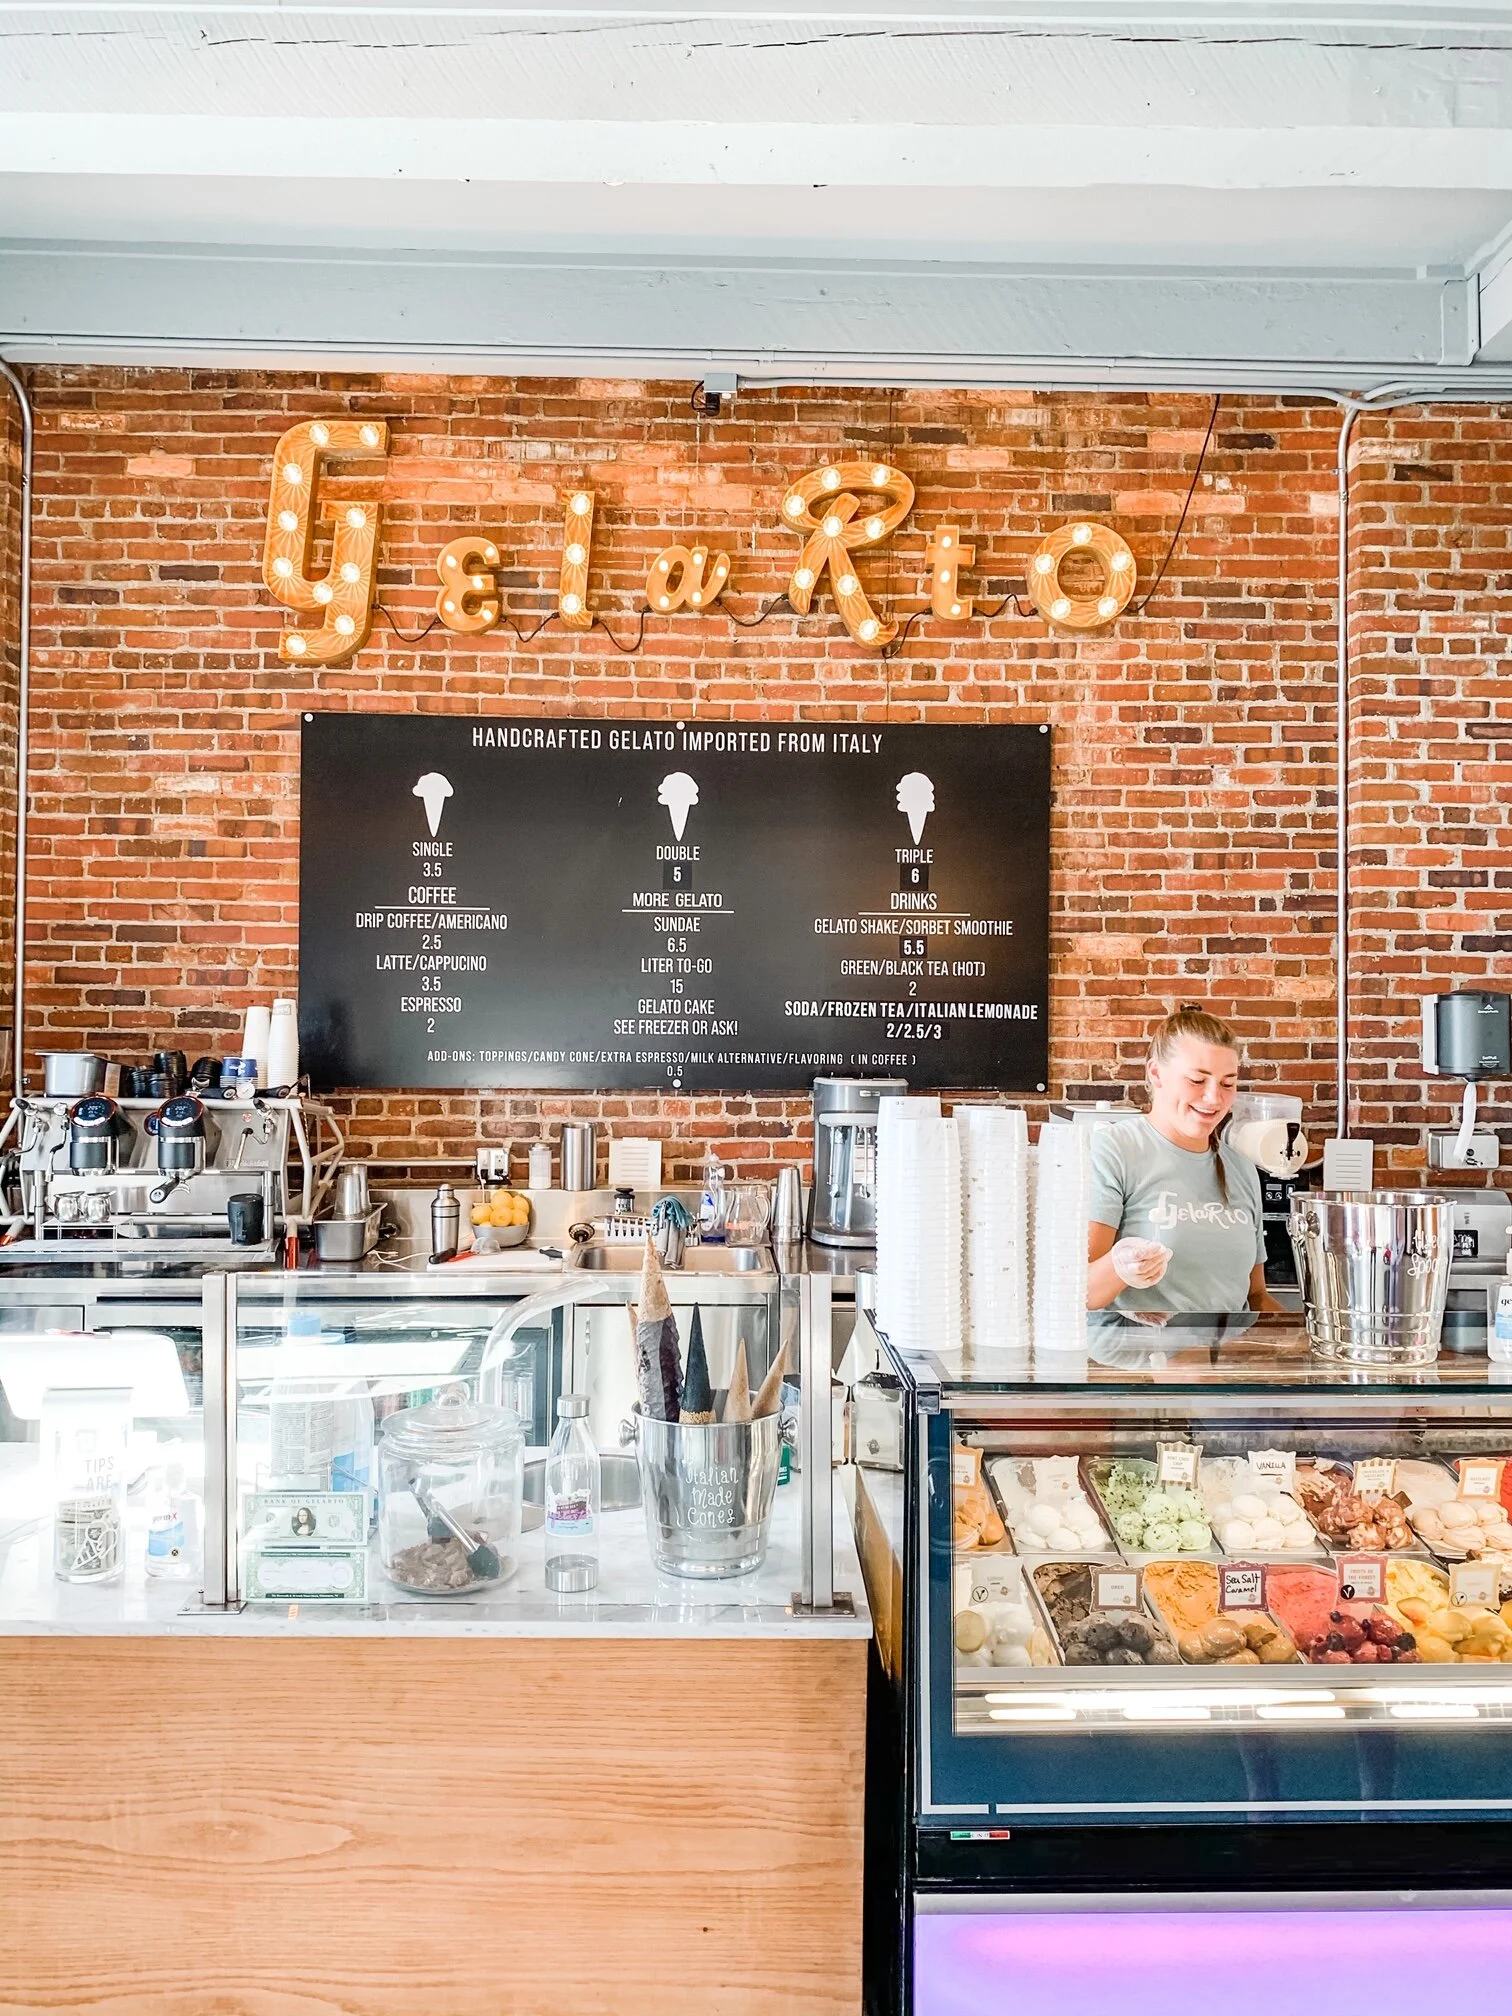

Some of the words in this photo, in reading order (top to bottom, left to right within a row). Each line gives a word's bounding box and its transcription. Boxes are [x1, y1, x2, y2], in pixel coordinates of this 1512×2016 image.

[472, 727, 602, 750] HANDCRAFTED
[609, 729, 675, 751] GELATO
[682, 731, 771, 752] IMPORTED
[778, 732, 825, 753] FROM
[833, 733, 883, 754] ITALY
[412, 841, 453, 857] SINGLE
[656, 845, 701, 861] DOUBLE
[894, 848, 934, 864] TRIPLE
[422, 861, 442, 878] 3.5
[673, 866, 682, 882] 5
[911, 867, 920, 884] 6
[408, 885, 457, 905] COFFEE
[634, 892, 670, 907] MORE
[675, 892, 723, 908] GELATO
[890, 892, 938, 911] DRINKS
[355, 912, 384, 928] DRIP
[387, 912, 508, 930] COFFEE/AMERICANO
[655, 916, 701, 932] SUNDAE
[814, 918, 858, 934] GELATO
[860, 918, 952, 935] SHAKE/SORBET
[953, 919, 1014, 936] SMOOTHIE
[422, 934, 442, 950] 2.5
[667, 937, 687, 953] 6.5
[903, 939, 925, 956] 5.5
[376, 953, 487, 972] LATTE/CAPPUCINO
[641, 957, 674, 973] LITER
[676, 957, 713, 974] TO-GO
[840, 958, 924, 976] GREEN/BLACK
[926, 960, 949, 976] TEA
[952, 961, 986, 977] (HOT)
[421, 975, 442, 992] 3.5
[669, 978, 684, 994] 15
[908, 980, 917, 996] 2
[400, 996, 462, 1013] ESPRESSO
[637, 998, 682, 1015] GELATO
[684, 999, 715, 1015] CAKE
[784, 1000, 877, 1018] SODA/FROZEN
[879, 1002, 967, 1018] TEA/ITALIAN
[968, 1002, 1038, 1020] LEMONADE
[427, 1017, 435, 1033] 2
[613, 1019, 636, 1035] SEE
[638, 1019, 689, 1035] FREEZER
[692, 1019, 708, 1036] OR
[710, 1020, 738, 1036] ASK!
[886, 1022, 942, 1040] 2/2.5/3
[427, 1050, 475, 1062] ADD-ONS:
[478, 1050, 566, 1063] TOPPINGS/CANDY
[569, 1050, 632, 1063] CONE/EXTRA
[634, 1051, 714, 1064] ESPRESSO/MILK
[717, 1052, 843, 1065] ALTERNATIVE/FLAVORING
[666, 1065, 683, 1077] 0.5
[85, 1456, 114, 1473] TIPS
[1255, 1461, 1287, 1471] VANILLA
[686, 1466, 739, 1486] Italian
[692, 1486, 733, 1509] Made
[687, 1507, 736, 1528] Cones
[1225, 1575, 1241, 1584] Sea
[1241, 1572, 1260, 1584] Salt
[1225, 1583, 1258, 1594] Caramel
